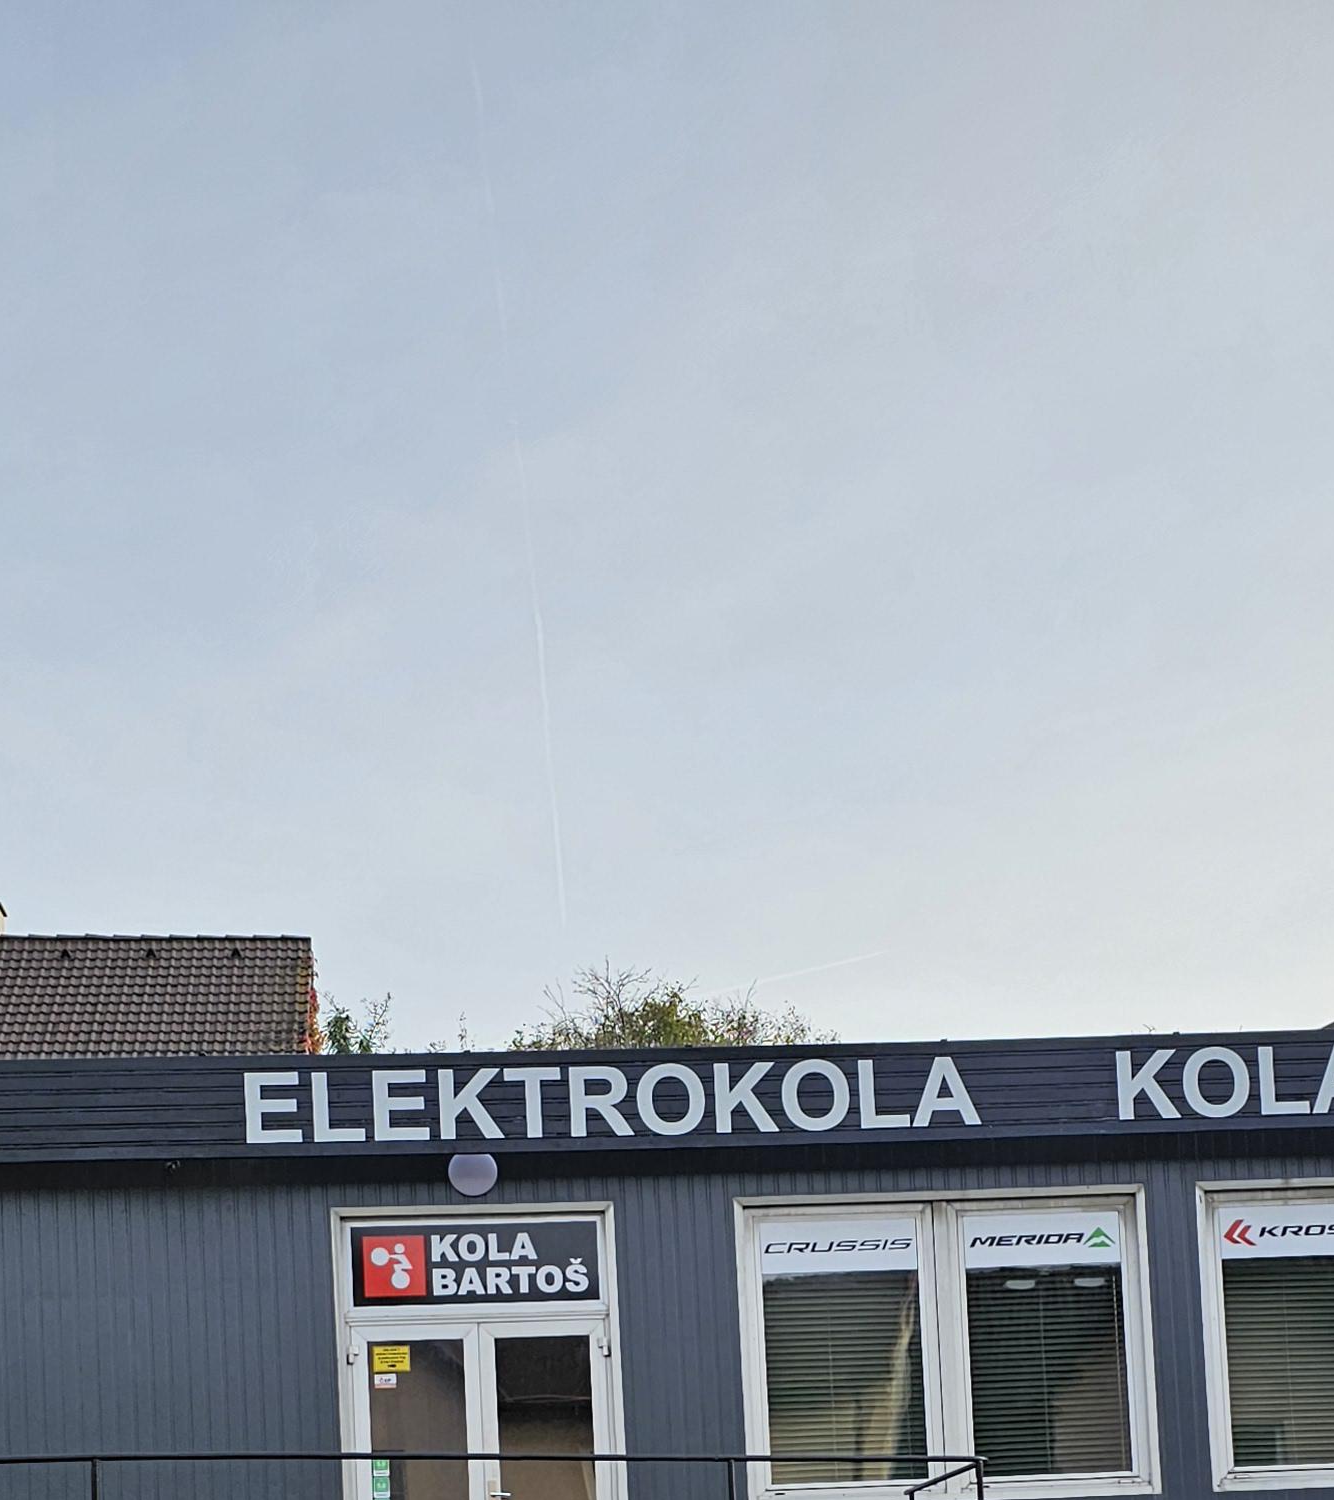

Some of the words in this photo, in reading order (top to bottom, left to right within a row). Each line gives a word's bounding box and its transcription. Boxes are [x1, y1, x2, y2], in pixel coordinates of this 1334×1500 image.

[243, 1056, 982, 1144] ELEKTROKOLA
[430, 1232, 538, 1262] KOLA
[764, 1238, 913, 1254] CRUSSIS
[969, 1232, 1085, 1249] MERIDA
[432, 1257, 590, 1296] BARTOŠ
